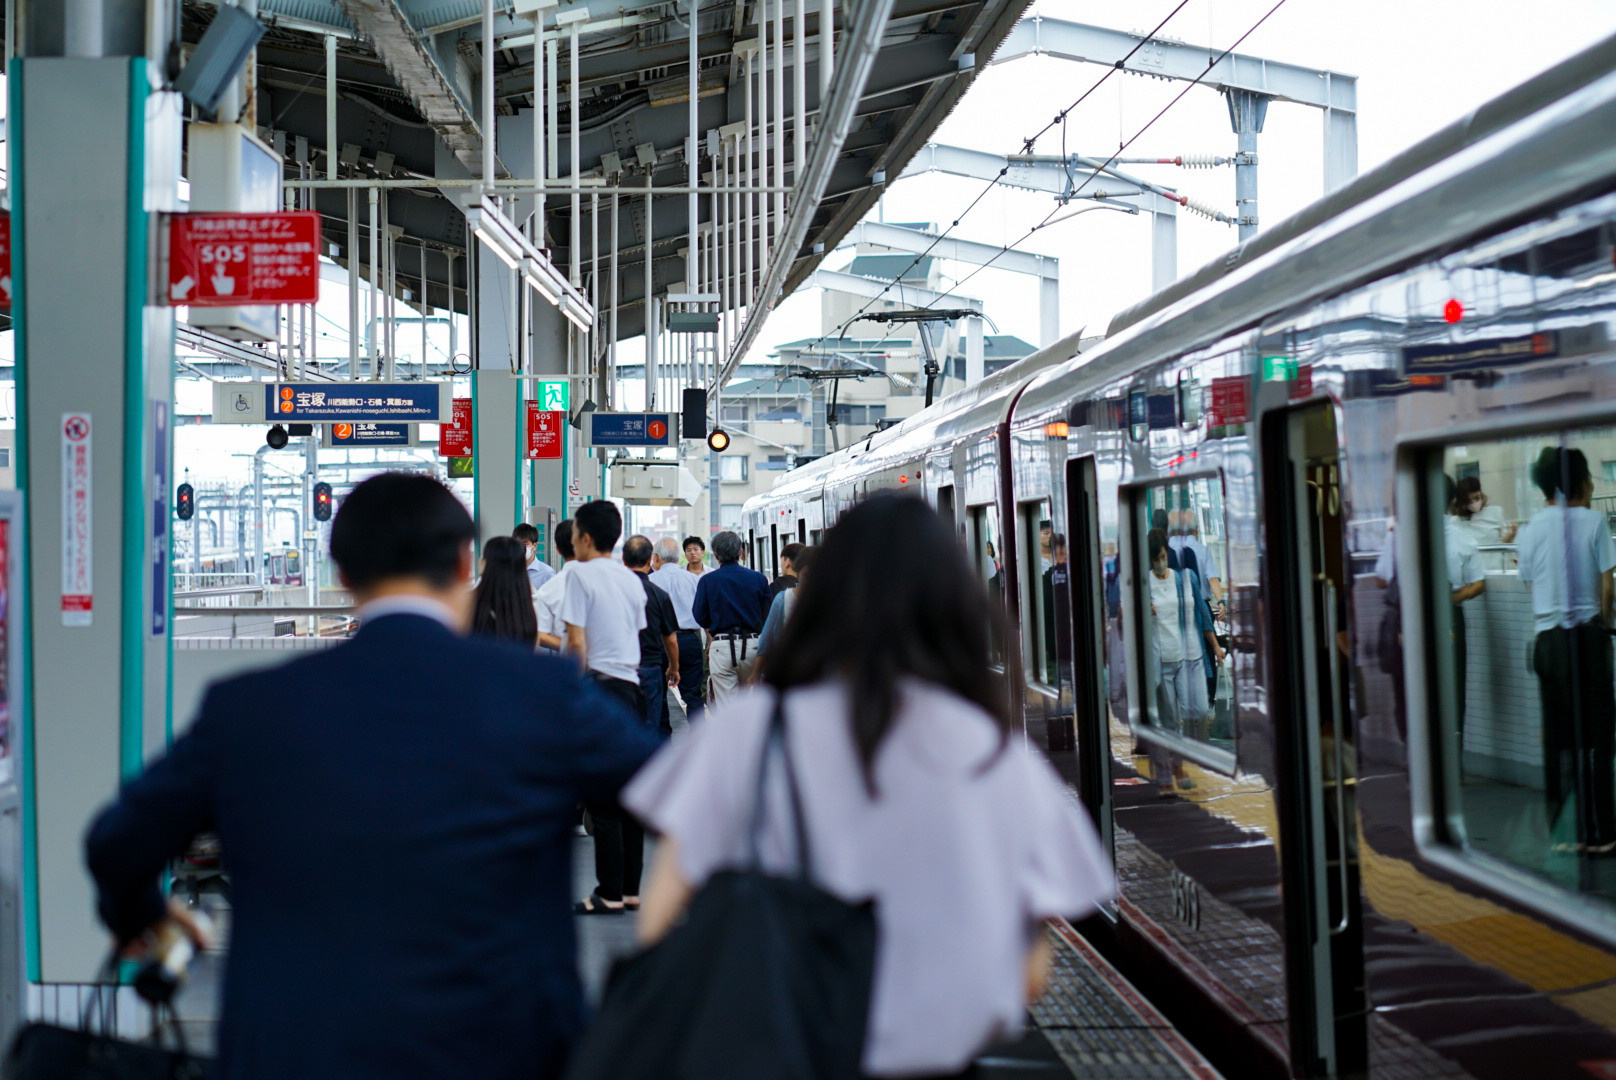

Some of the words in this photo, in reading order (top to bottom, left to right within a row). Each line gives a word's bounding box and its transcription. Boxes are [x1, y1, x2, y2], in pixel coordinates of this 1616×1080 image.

[200, 244, 246, 263] SOS
[296, 391, 326, 407] 宝塚
[338, 424, 348, 437] 2
[623, 420, 643, 431] 宝塚
